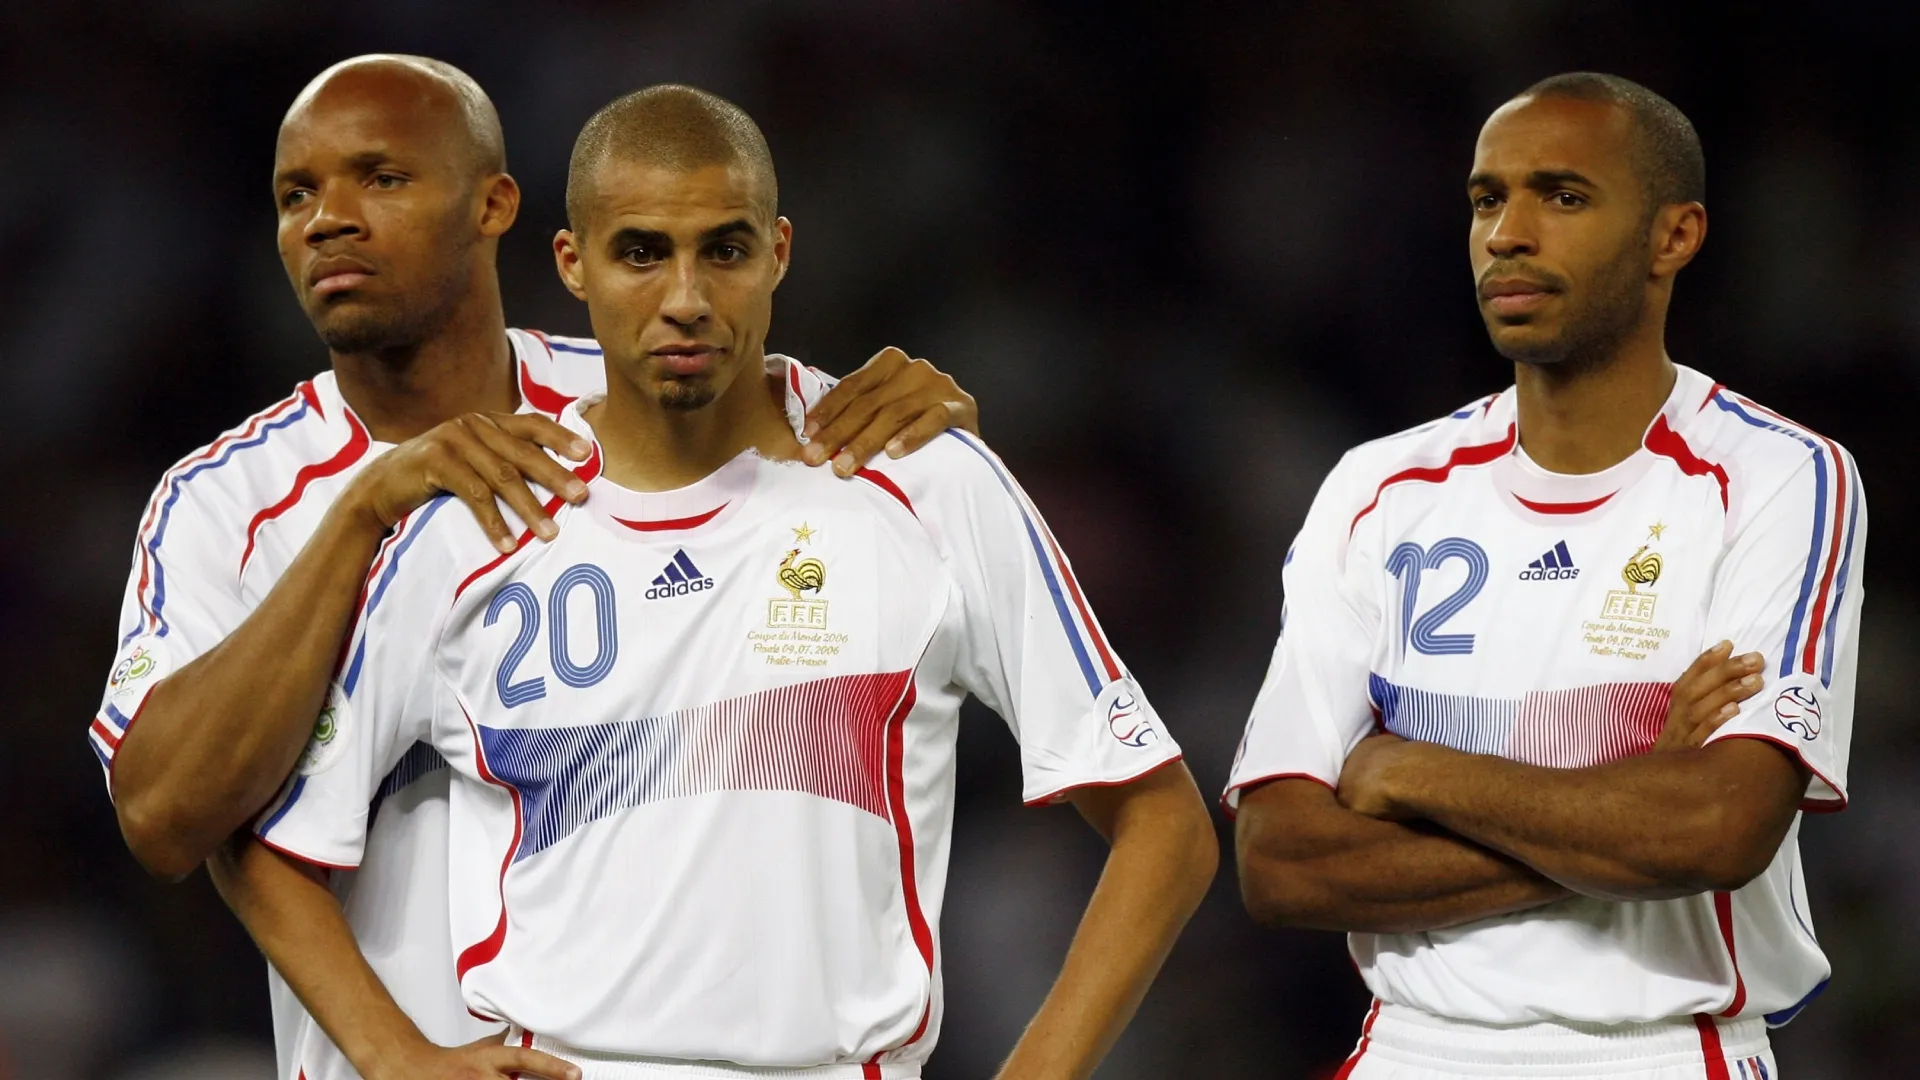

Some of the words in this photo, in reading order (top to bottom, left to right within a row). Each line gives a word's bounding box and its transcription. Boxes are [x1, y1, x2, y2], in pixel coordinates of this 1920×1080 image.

[1518, 566, 1580, 581] adidas
[645, 575, 714, 600] adidas
[1385, 537, 1490, 664] 12
[484, 563, 618, 709] 20
[823, 633, 849, 643] 2006
